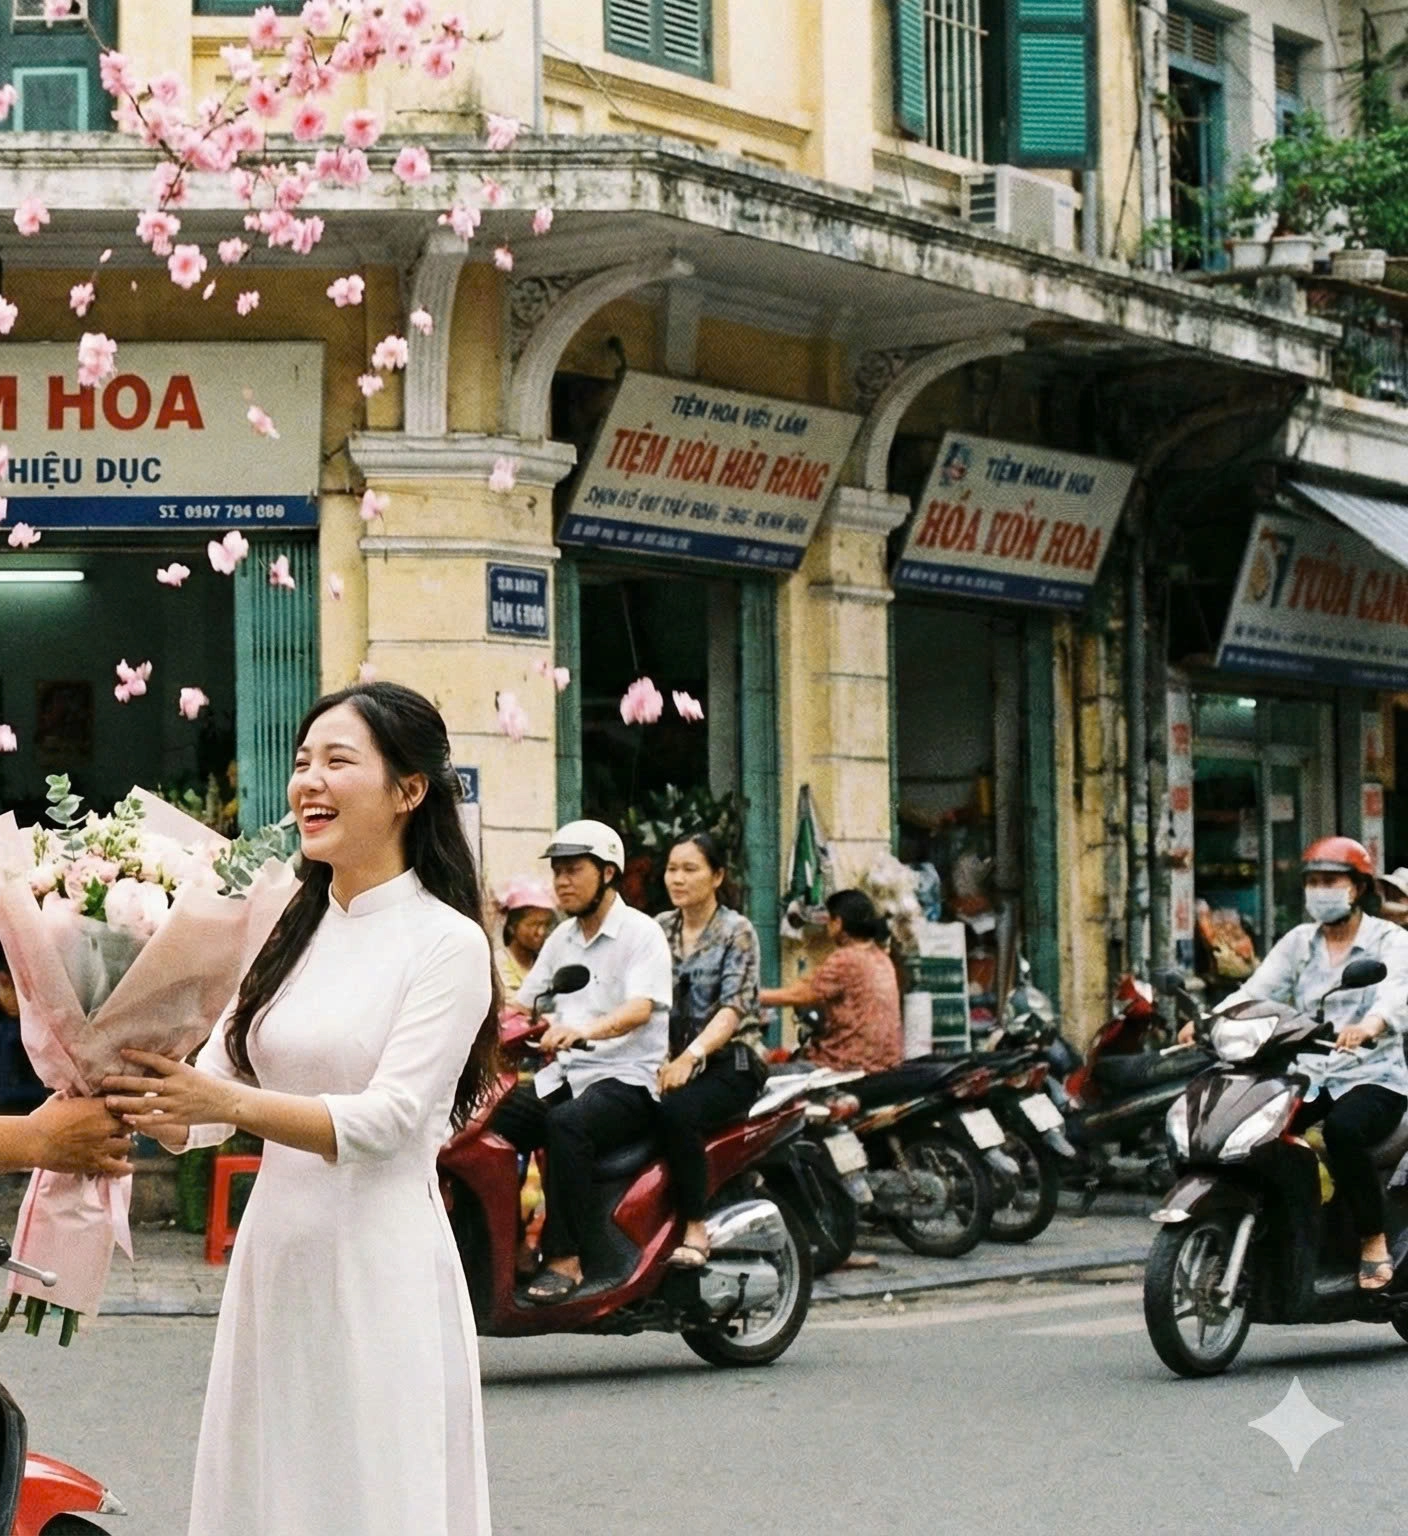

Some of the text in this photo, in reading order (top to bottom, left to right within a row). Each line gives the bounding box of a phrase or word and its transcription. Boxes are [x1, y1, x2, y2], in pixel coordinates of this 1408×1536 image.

[48, 373, 205, 430] HOA
[8, 451, 82, 490] HIỆU
[96, 458, 161, 488] DỤC
